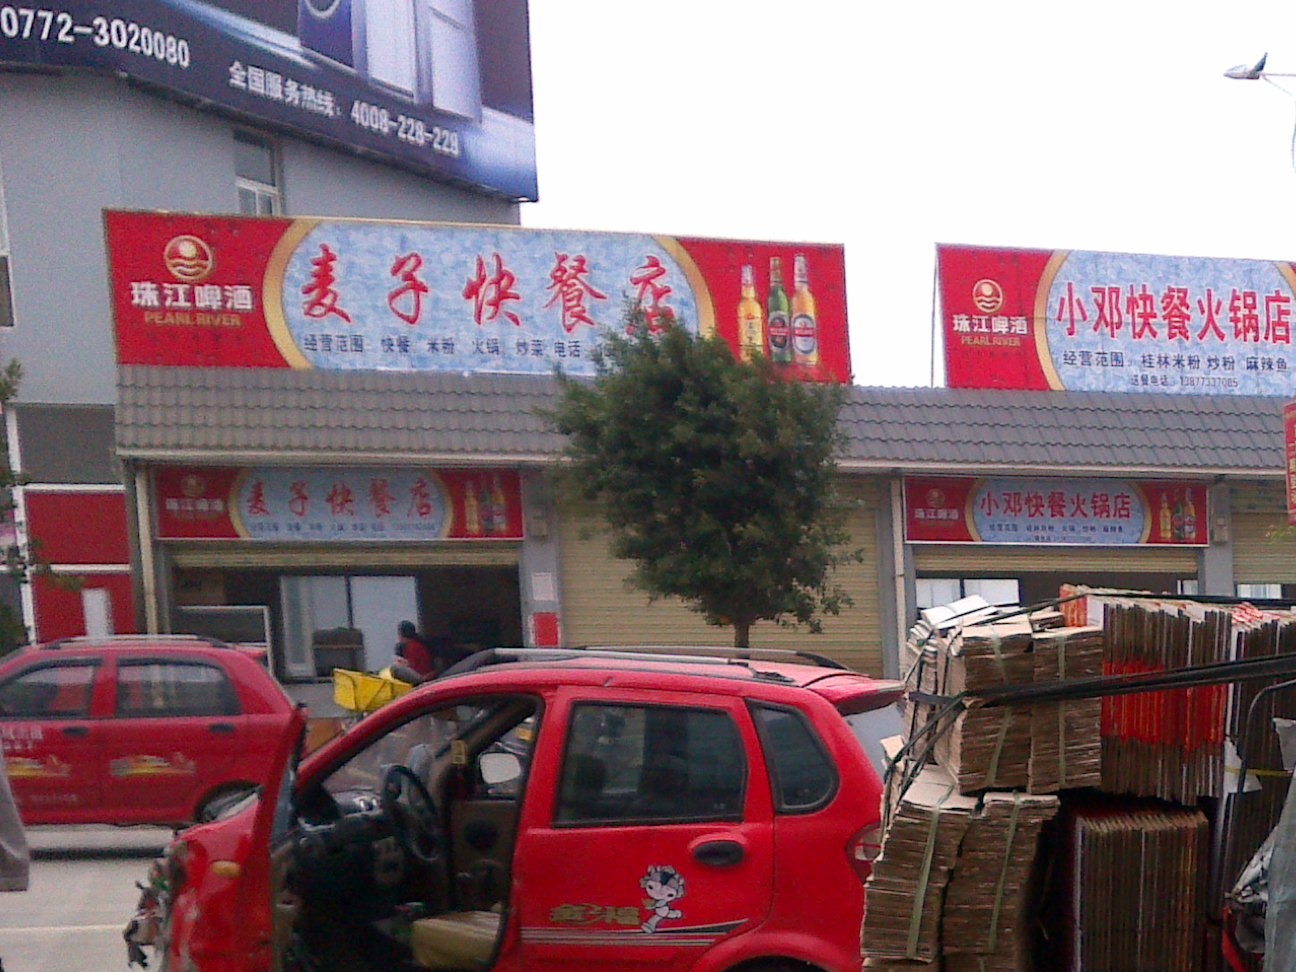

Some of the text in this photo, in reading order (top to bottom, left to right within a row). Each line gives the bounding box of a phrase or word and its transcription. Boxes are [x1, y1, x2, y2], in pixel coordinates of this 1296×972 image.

[1, 6, 191, 69] 0772-3020080
[131, 281, 253, 311] 珠江啤酒
[301, 243, 675, 335] 麦子快餐店
[144, 313, 241, 327] PEARL RIVER
[952, 314, 1028, 334] 珠江啤酒
[1056, 282, 1292, 345] 小邓快餐火锅店
[304, 334, 364, 353] 经营范围
[381, 335, 410, 353] 快餐
[554, 340, 581, 358] 电话
[961, 335, 991, 346] PEARL
[1063, 351, 1288, 373] 经营范围 桂林米粉 炒粉 麻辣鱼
[246, 478, 434, 518] 麦子快餐店
[980, 491, 1132, 519] 小邓快餐火锅店
